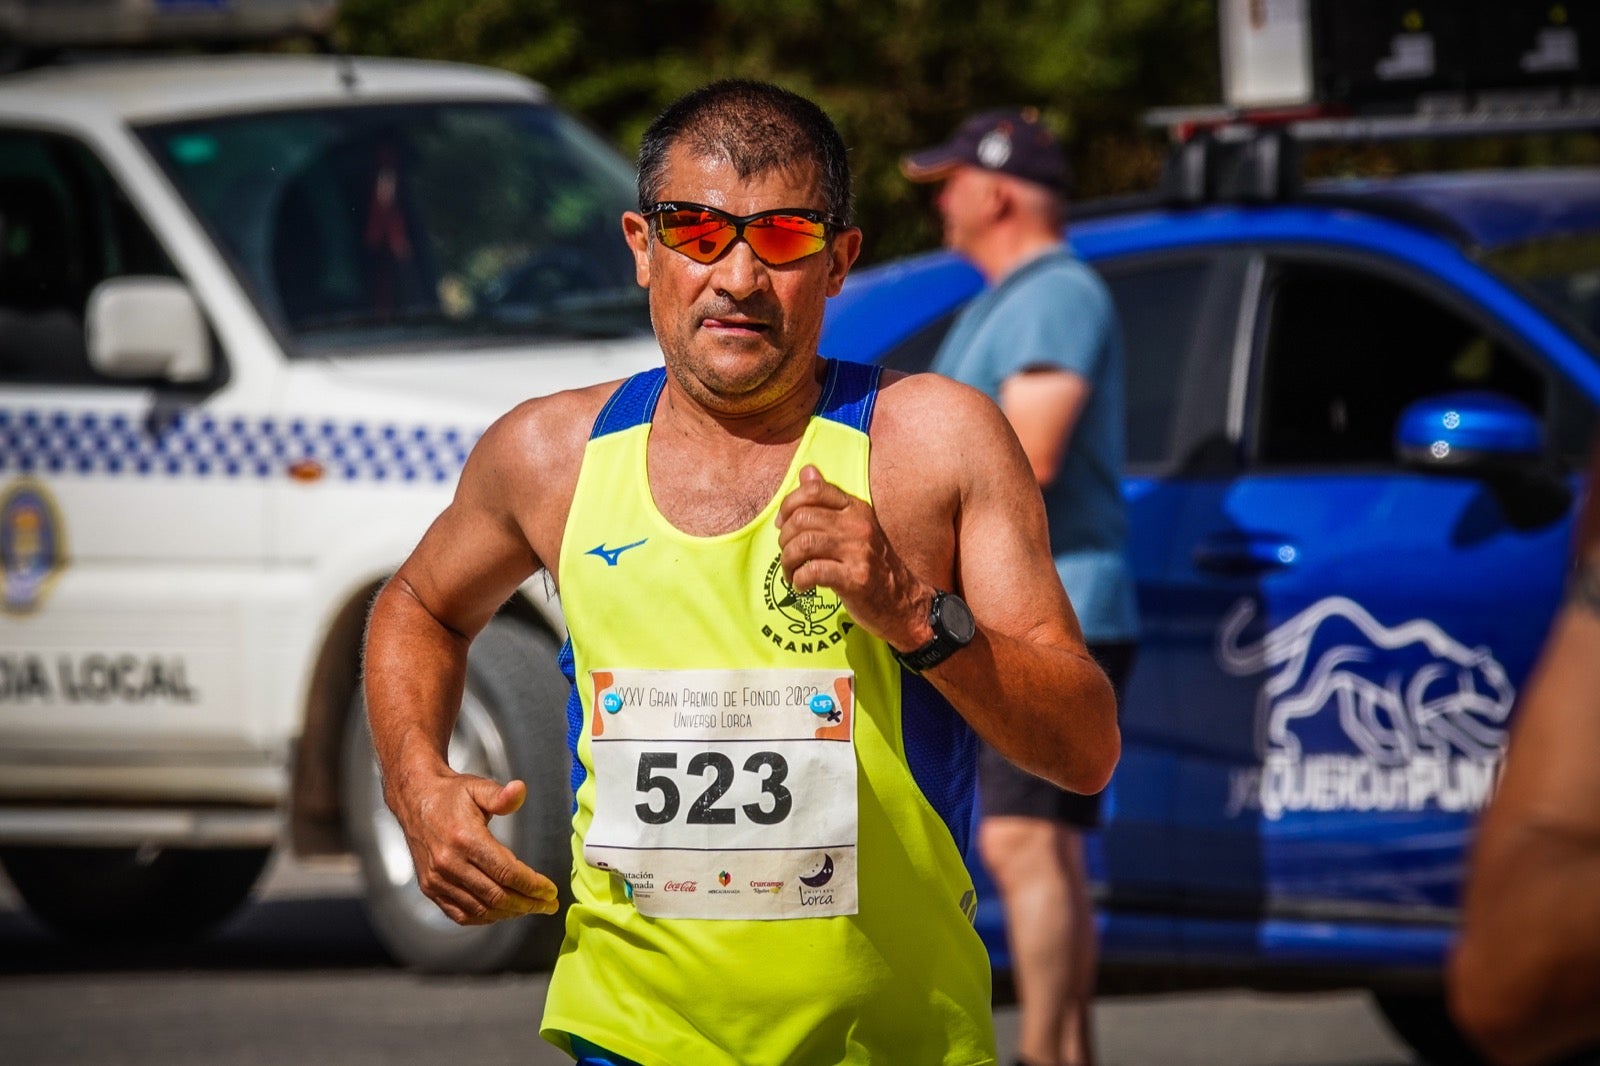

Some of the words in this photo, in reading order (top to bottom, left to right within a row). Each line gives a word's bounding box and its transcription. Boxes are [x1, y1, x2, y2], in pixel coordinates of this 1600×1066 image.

[764, 553, 782, 610] ATLETISM
[761, 622, 854, 654] GRANADA
[57, 654, 201, 703] LOCAL
[723, 690, 738, 708] DE
[635, 751, 793, 825] 523
[750, 880, 785, 888] Cruzcampo
[799, 885, 835, 906] Lorca
